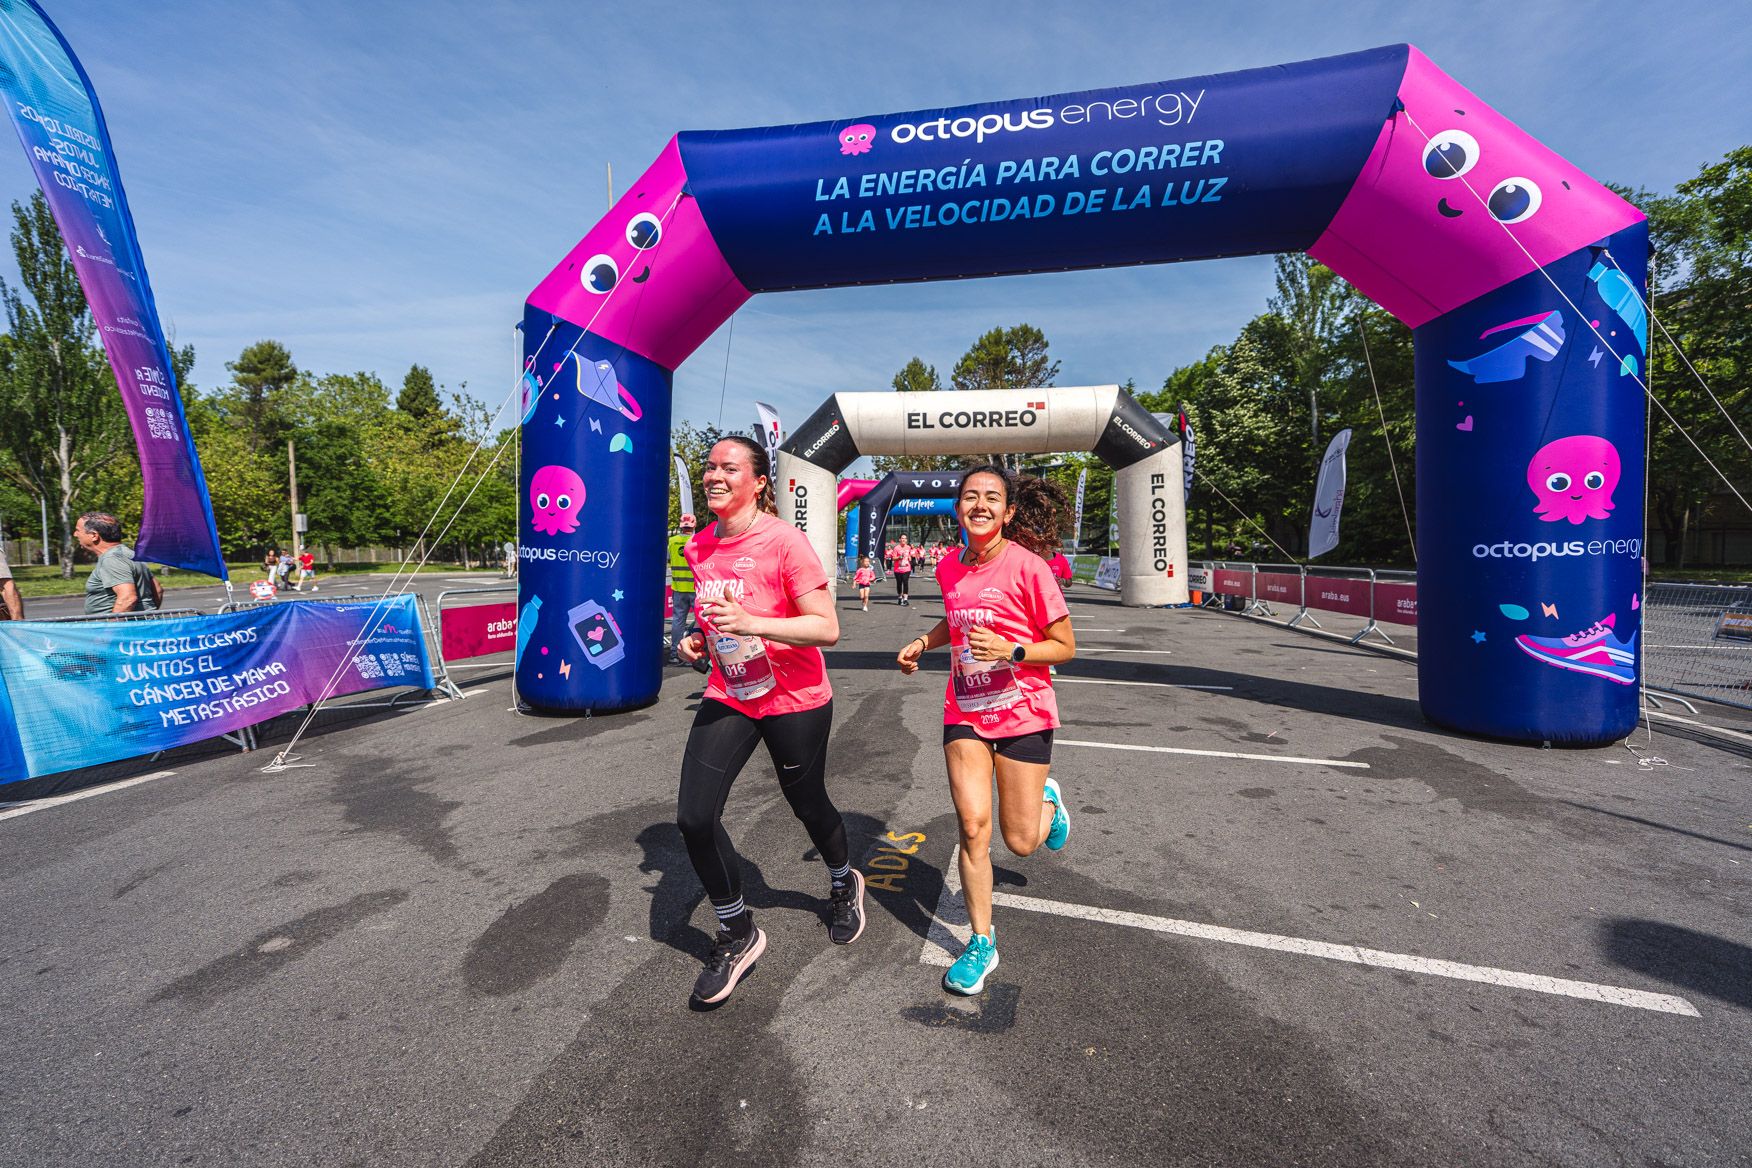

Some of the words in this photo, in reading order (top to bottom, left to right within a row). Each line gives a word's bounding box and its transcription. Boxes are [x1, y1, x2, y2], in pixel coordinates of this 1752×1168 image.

[891, 107, 1054, 144] octopus
[1060, 89, 1205, 126] energy
[814, 177, 850, 202] LA
[859, 158, 987, 198] ENERGÍA
[996, 153, 1081, 185] PARA
[1090, 139, 1225, 176] CORRER
[813, 213, 833, 236] A
[841, 208, 877, 233] LA
[886, 193, 1056, 230] VELOCIDAD
[1062, 189, 1105, 215] DE
[1112, 186, 1152, 212] LA
[1160, 177, 1228, 206] LUZ
[907, 412, 935, 430] EL
[938, 409, 1037, 428] CORREO
[1113, 415, 1124, 429] EL
[1121, 423, 1151, 450] CORREO
[804, 447, 814, 458] EL
[813, 424, 840, 450] CORREO
[911, 479, 960, 488] VOL
[1151, 473, 1165, 496] EL
[795, 485, 808, 532] RREO
[898, 498, 935, 512] Marlene
[1151, 497, 1168, 573] CORREO
[558, 549, 620, 568] energy
[1472, 541, 1585, 562] octopus
[1587, 538, 1642, 560] energy
[1321, 591, 1350, 602] araba.eus
[487, 618, 513, 633] araba
[119, 626, 258, 657] VISIBILICEMOS
[116, 655, 194, 684] JUNTOS
[199, 655, 222, 673] EL
[129, 680, 206, 707] CÁNCER
[208, 676, 234, 696] DE
[234, 661, 287, 690] MAMA
[725, 663, 747, 677] 016
[965, 673, 992, 688] 016
[159, 678, 290, 728] METASTÁSICO
